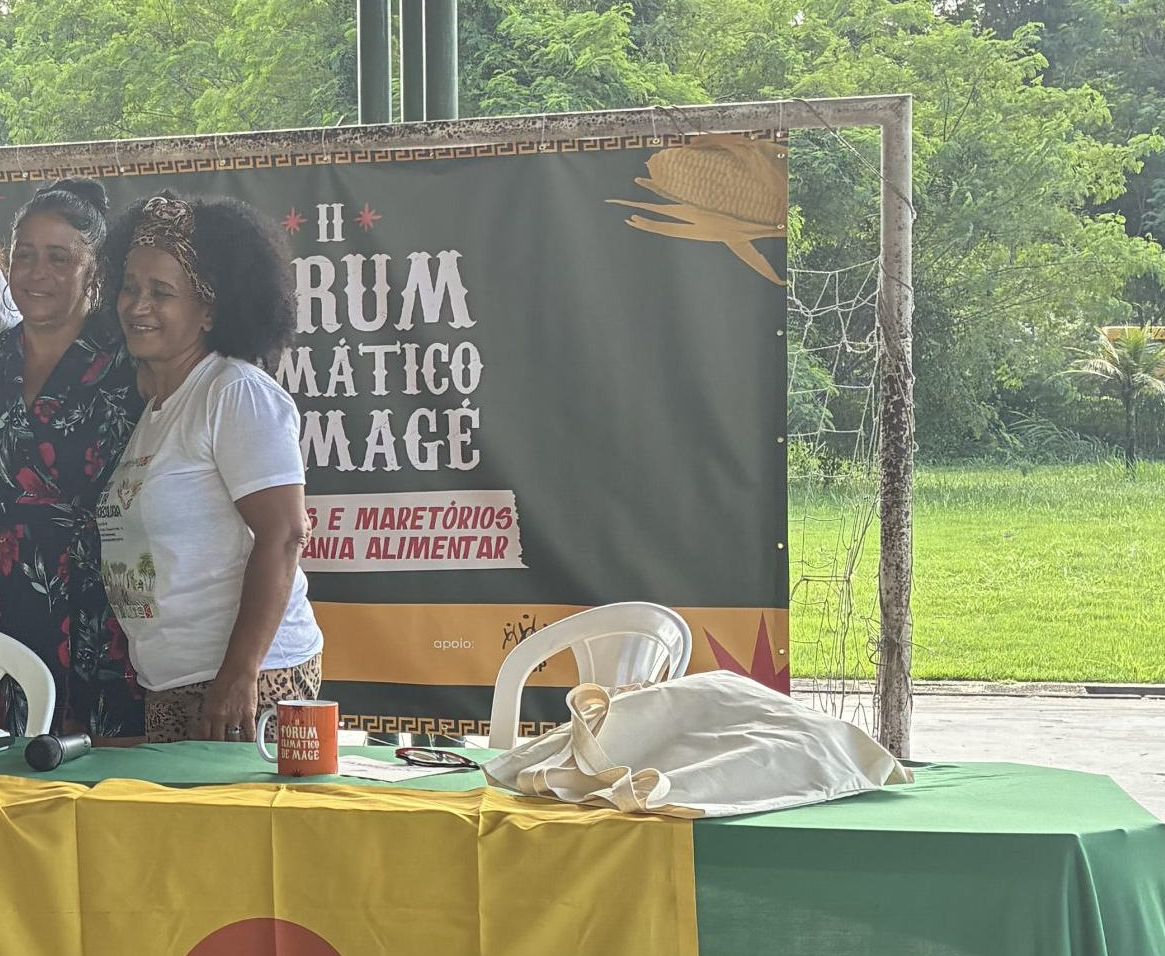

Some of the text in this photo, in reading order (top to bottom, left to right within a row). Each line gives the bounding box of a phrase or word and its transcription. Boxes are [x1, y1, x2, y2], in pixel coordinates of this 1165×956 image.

[316, 203, 345, 242] II
[291, 250, 477, 334] RUM
[276, 338, 484, 398] MÁTICO
[300, 398, 480, 473] MAGÉ
[328, 507, 345, 531] E
[354, 501, 513, 531] MARETÓRIOS
[301, 535, 510, 560] ANIA ALIMENTAR
[433, 637, 475, 650] apoio:
